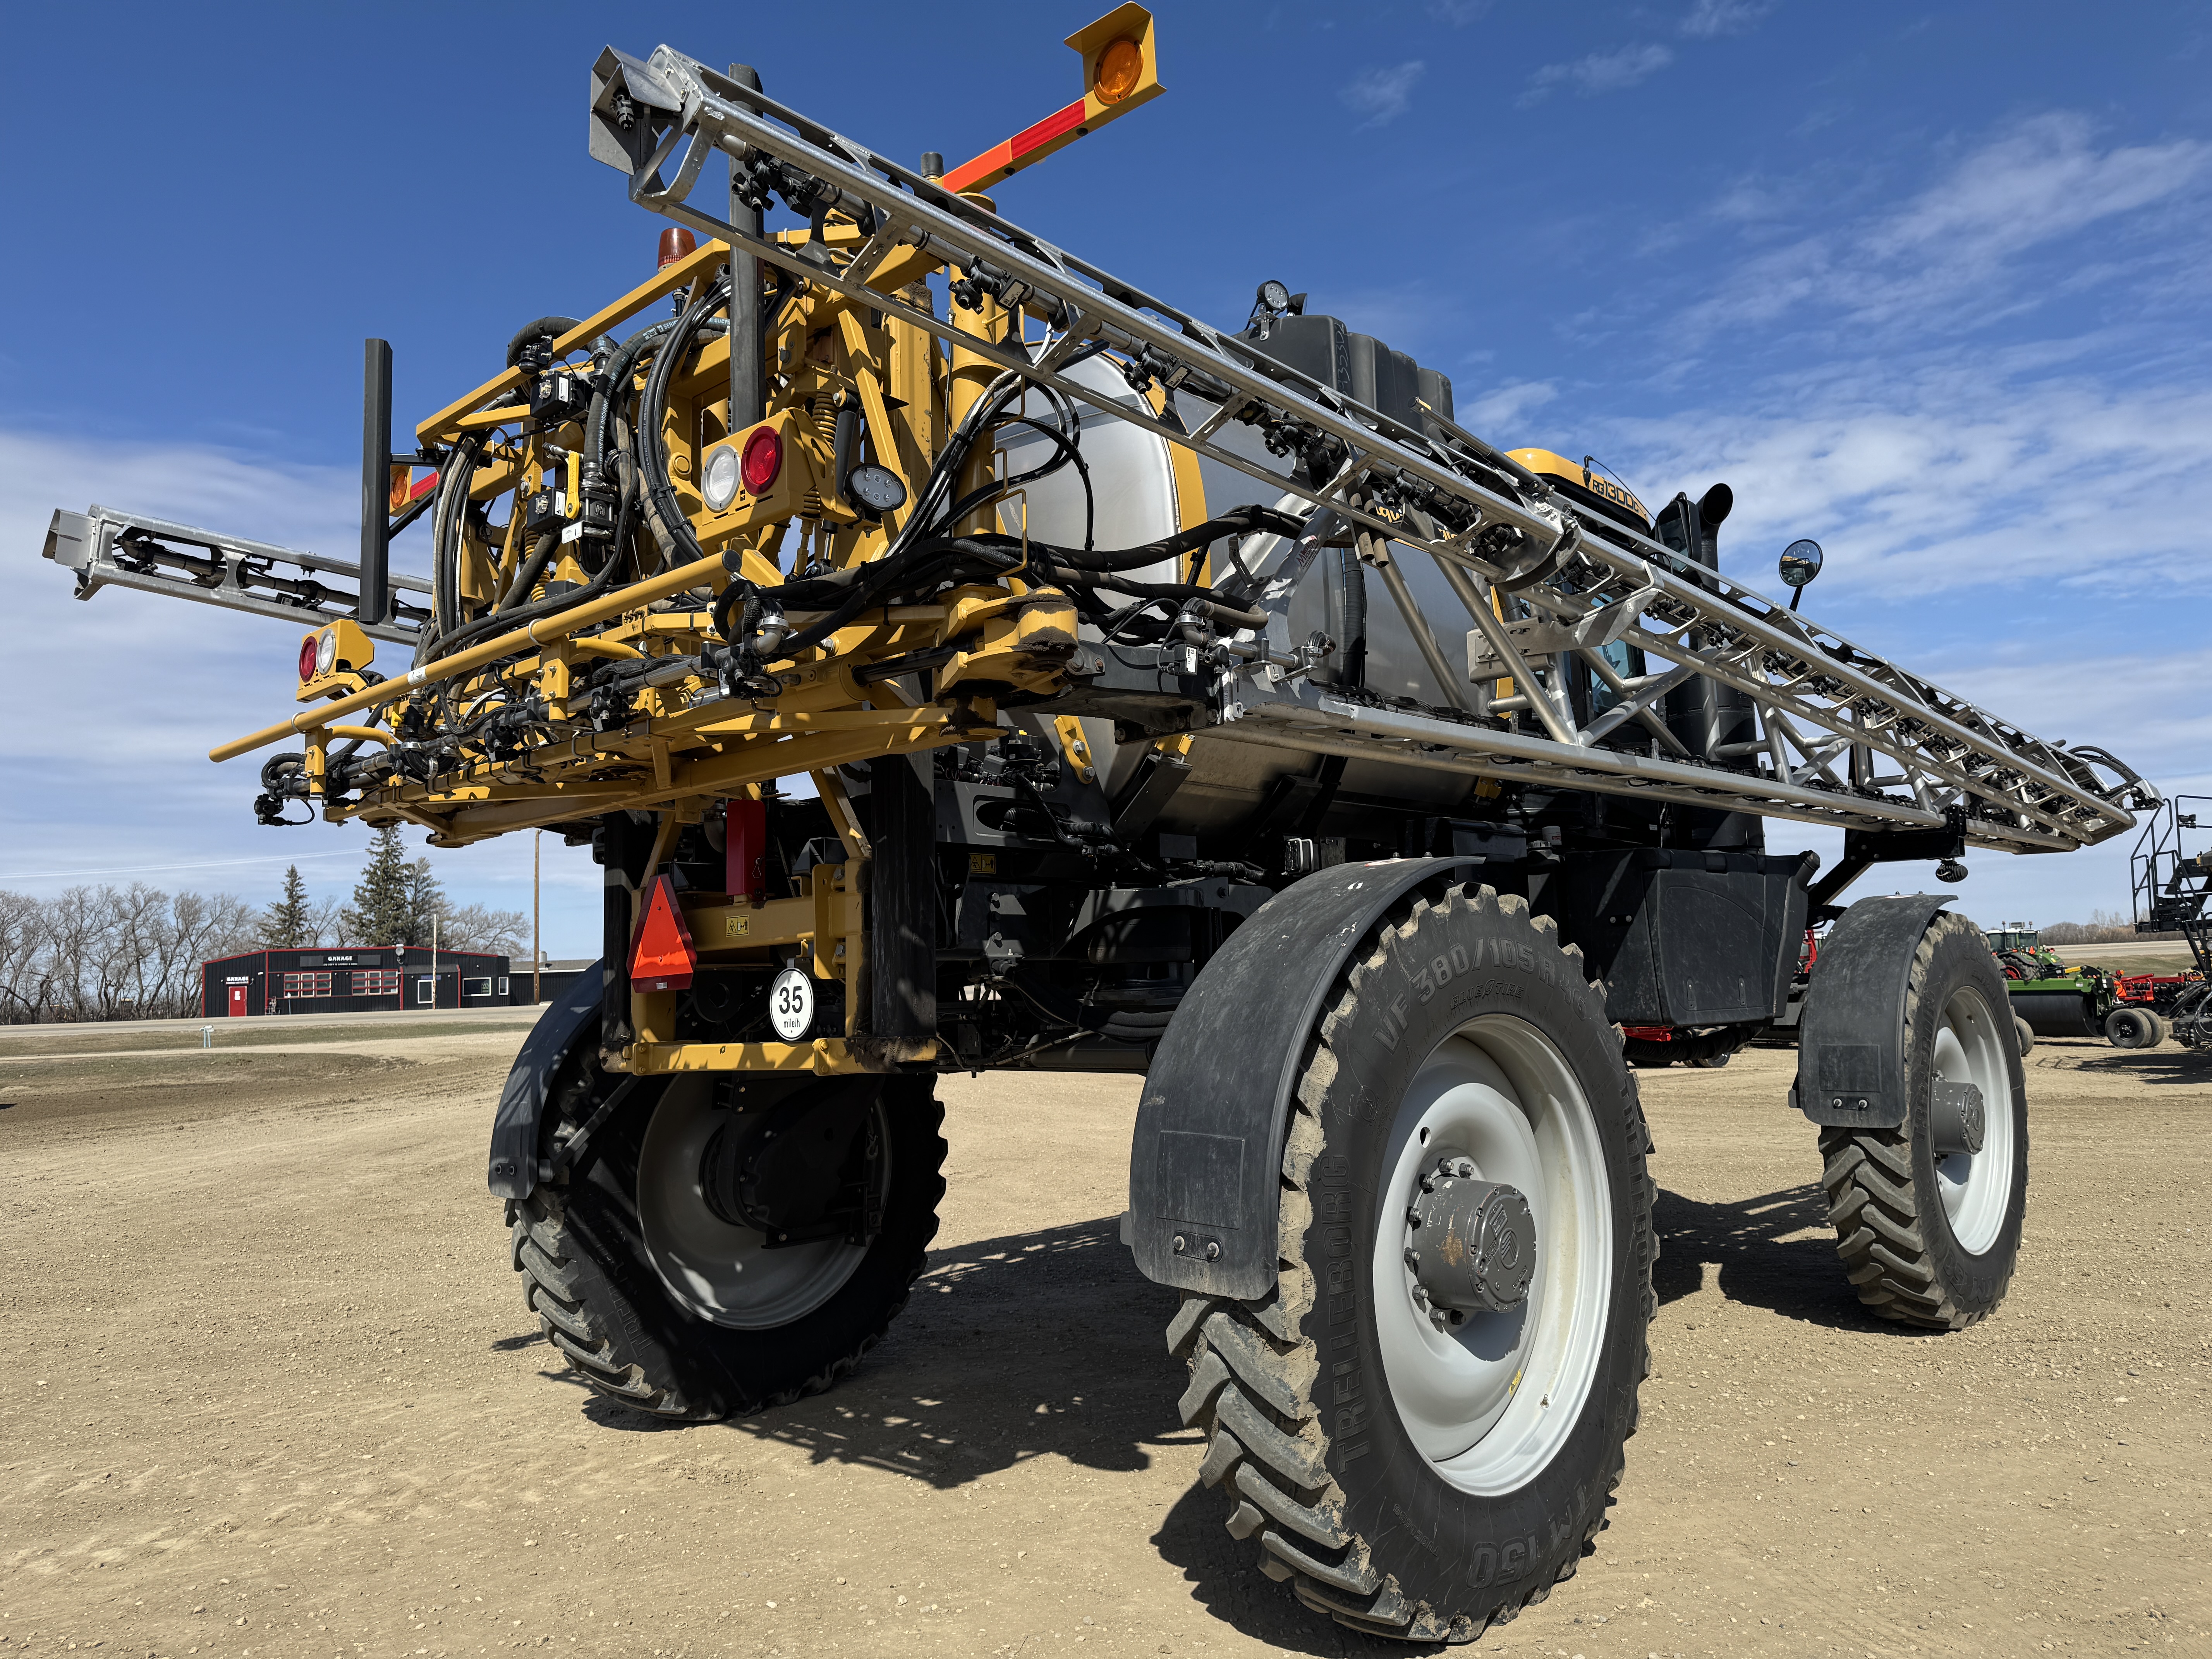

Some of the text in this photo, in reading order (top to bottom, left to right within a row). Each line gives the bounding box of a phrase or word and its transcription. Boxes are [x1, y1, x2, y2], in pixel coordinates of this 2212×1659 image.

[779, 986, 803, 1014] 35
[1372, 990, 1410, 1054] VF
[1410, 936, 1534, 1006] 380/105
[1538, 951, 1556, 989] R
[1451, 982, 1524, 1010] BLUE TIRE
[783, 1018, 800, 1029] mile/h
[1318, 1154, 1370, 1475] TRELLEBORG
[1393, 1503, 1439, 1557] TUBELESS
[1466, 1529, 1538, 1589] 150
